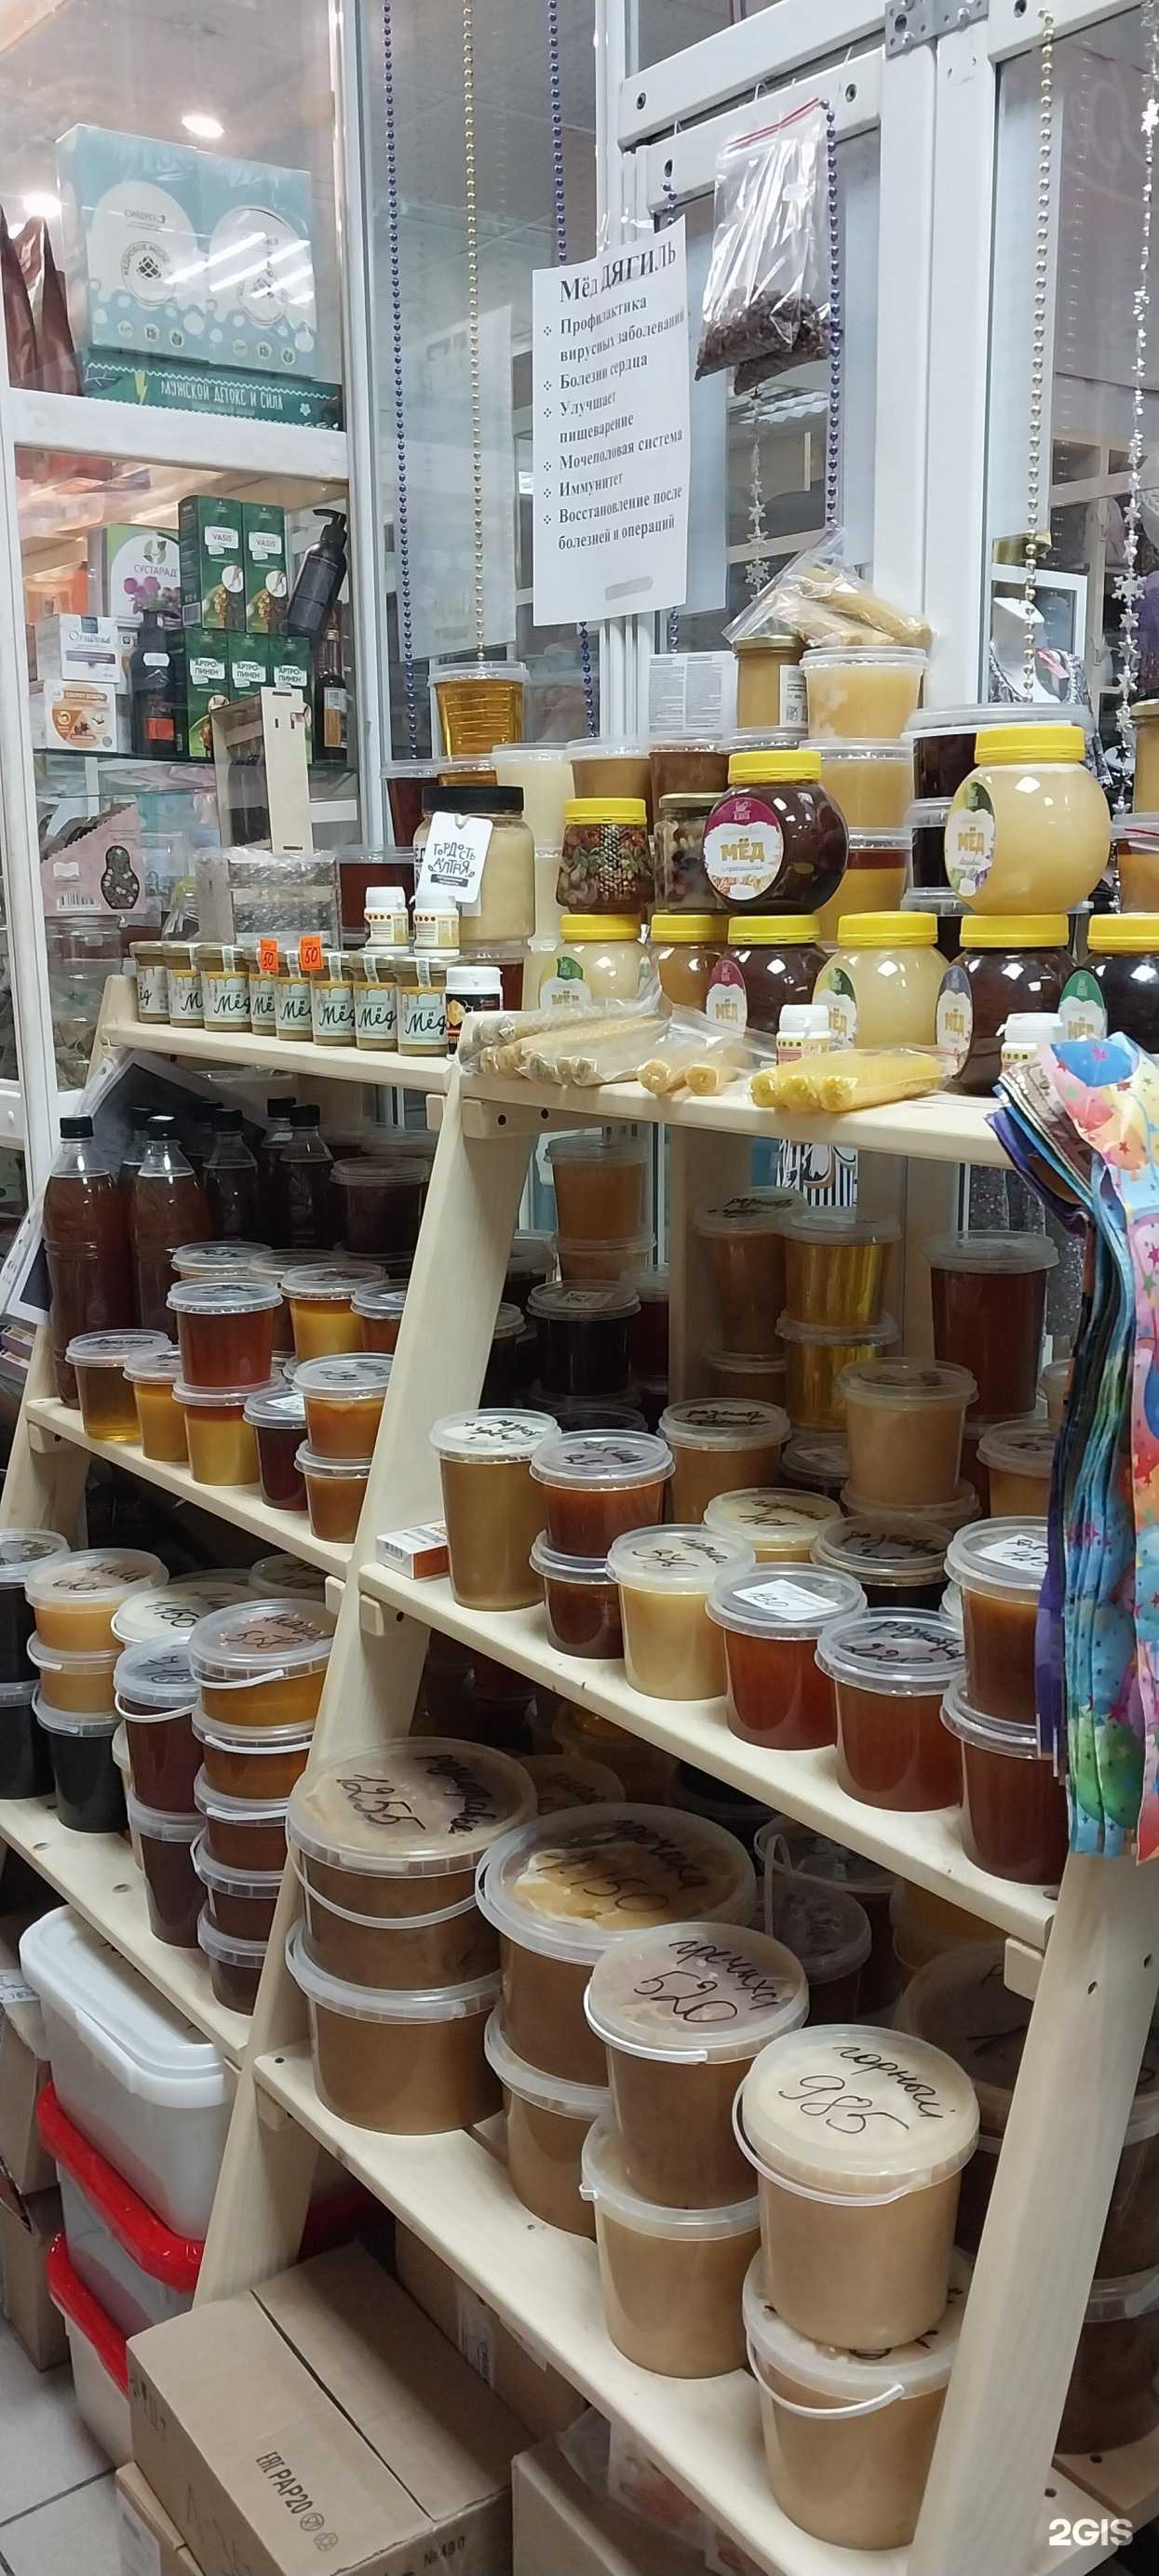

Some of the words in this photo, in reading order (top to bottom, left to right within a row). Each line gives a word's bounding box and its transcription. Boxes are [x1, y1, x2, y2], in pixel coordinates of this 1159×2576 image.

[559, 276, 598, 302] Мёд
[601, 242, 677, 292] ДЯГИЛЬ
[560, 297, 647, 336] Профилактика
[560, 336, 614, 363] вирусных
[618, 308, 684, 343] заболеваний
[560, 368, 607, 389] Болезни
[610, 355, 647, 379] сердца
[161, 380, 209, 400] МУЖСКОЙ
[213, 386, 246, 406] ДЕТОКС
[249, 392, 257, 407] И
[261, 391, 283, 409] СИЛА
[559, 392, 616, 417] Улучшает
[559, 414, 634, 443] пищеварение
[559, 442, 635, 470] Мочеполовая
[638, 429, 682, 451] система
[559, 473, 623, 496] Иммунитет
[559, 494, 650, 523] Восстановление
[654, 487, 682, 504] после
[559, 530, 611, 550] болезней
[613, 531, 619, 541] и
[621, 515, 675, 539] операций
[195, 667, 219, 676] ПИНЕН
[720, 838, 765, 863] МЁД
[958, 826, 985, 855] МЁД
[263, 951, 275, 967] 50
[304, 947, 318, 964] 50
[252, 996, 276, 1015] Мё
[336, 1774, 426, 1831] 1255
[634, 1970, 737, 2023] 520
[832, 2046, 957, 2119] горный
[778, 2075, 910, 2134] 985
[268, 2468, 313, 2514] PAP20
